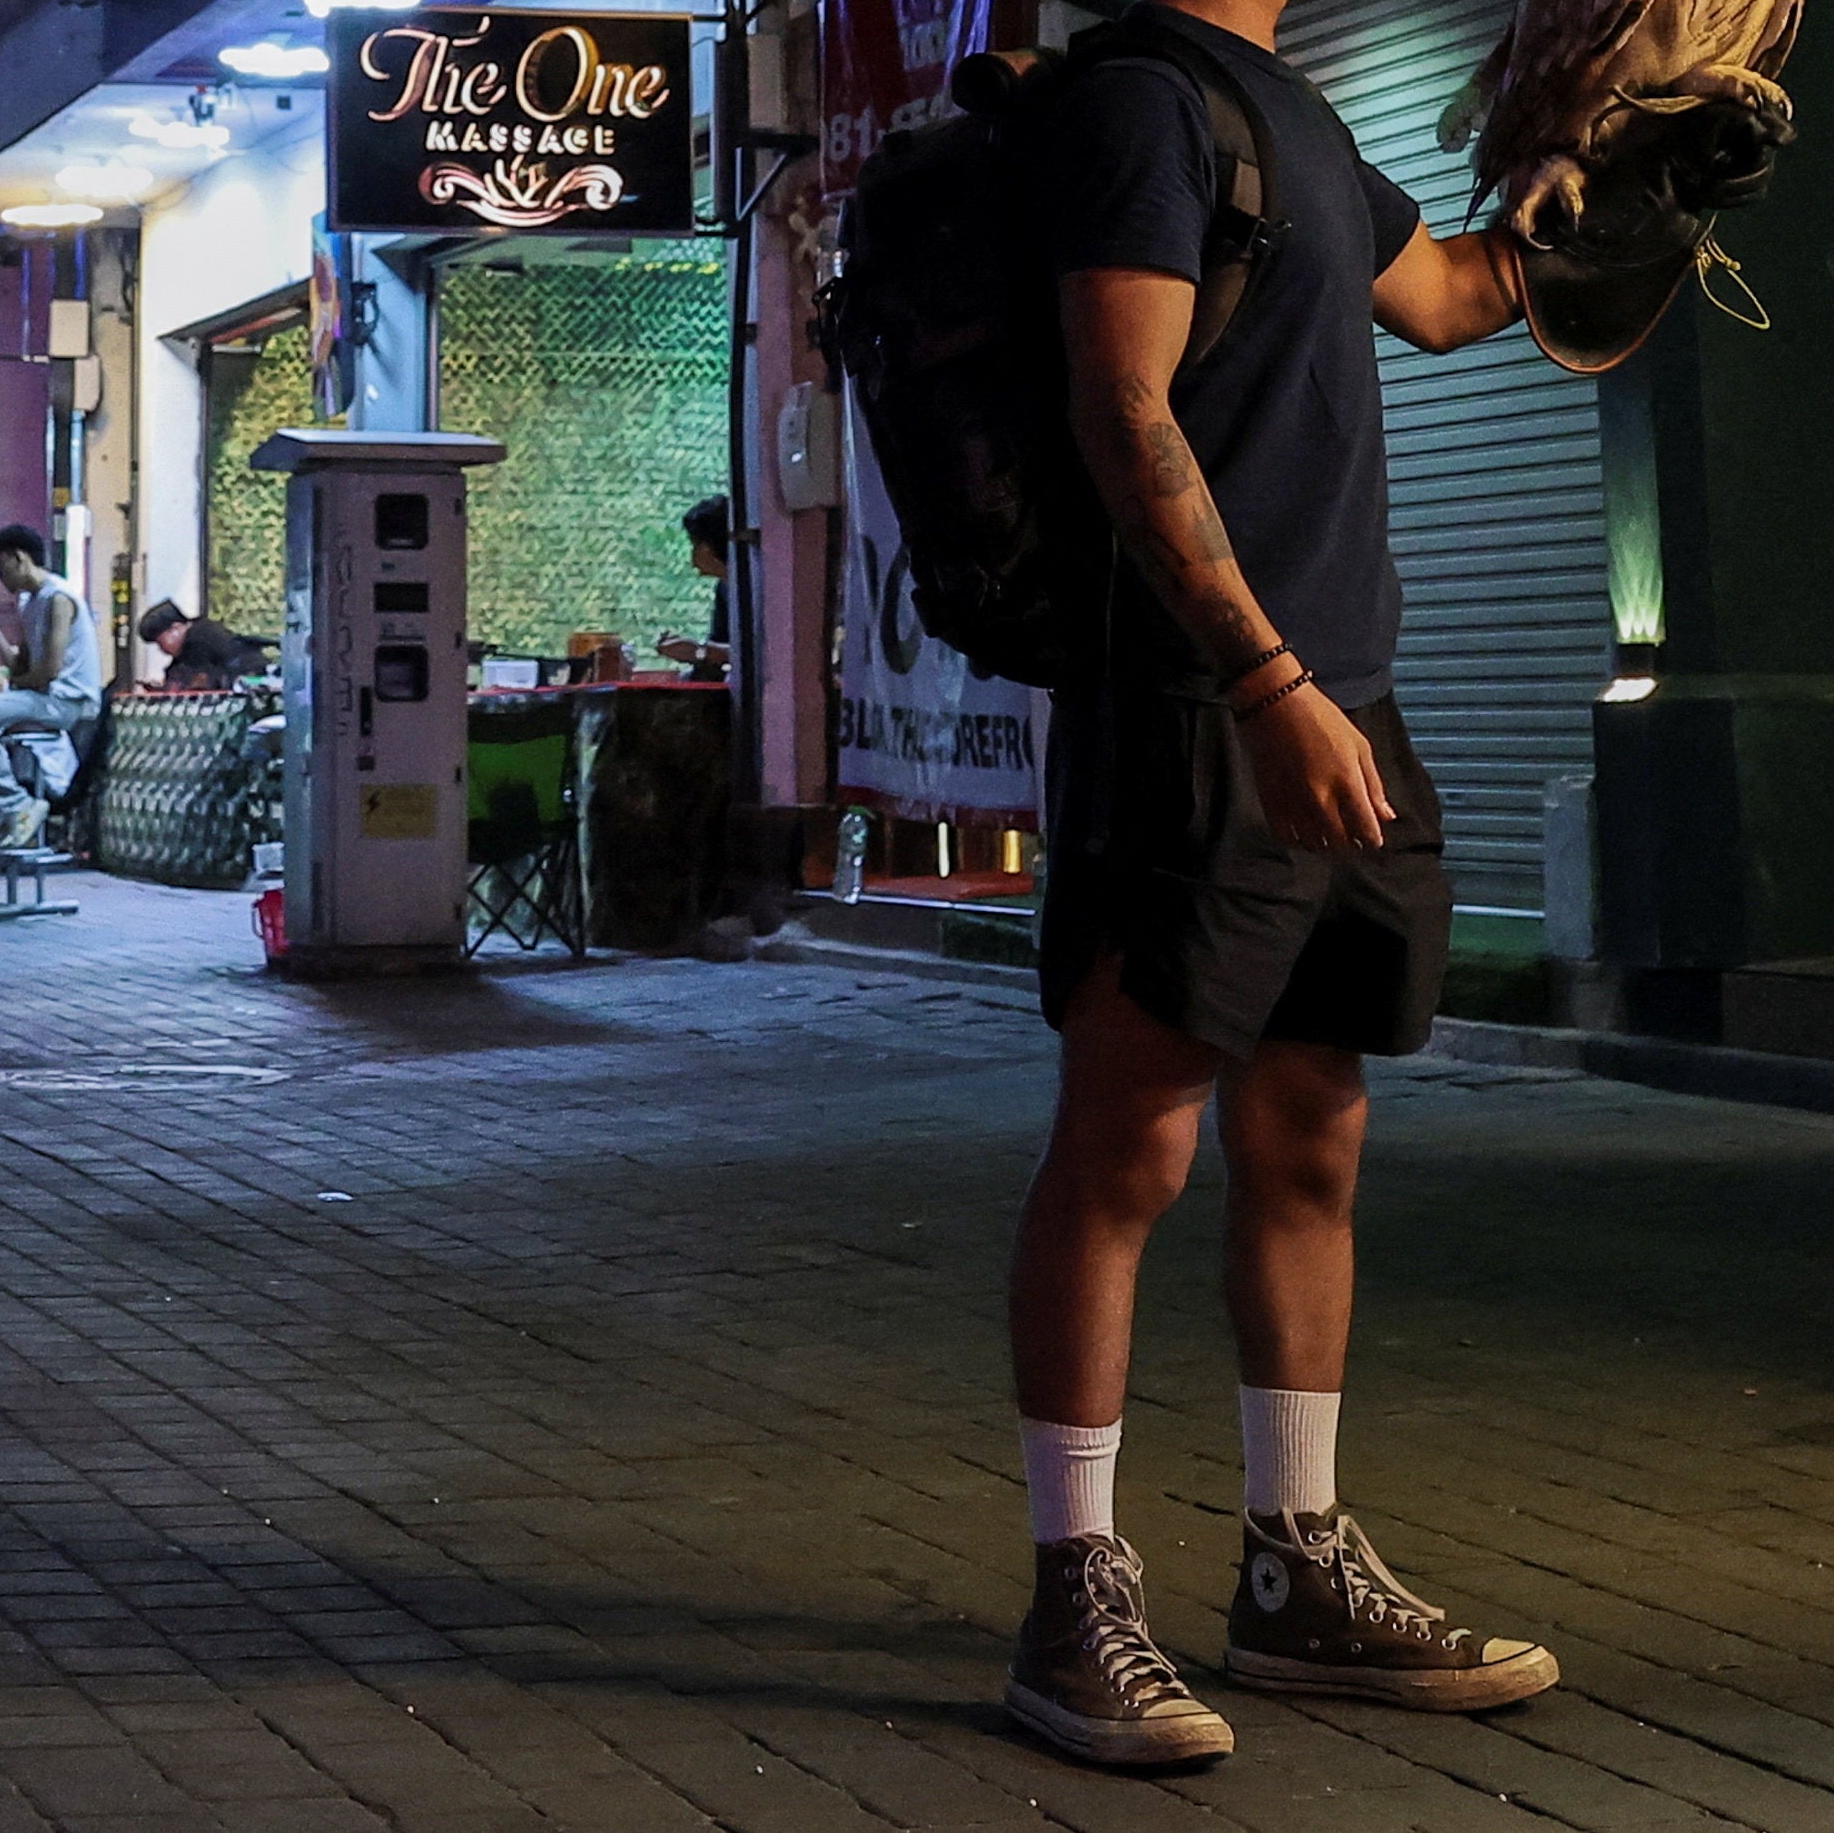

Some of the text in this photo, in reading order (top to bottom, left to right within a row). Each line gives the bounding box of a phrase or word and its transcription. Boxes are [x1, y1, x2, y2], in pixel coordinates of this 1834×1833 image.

[360, 15, 671, 123] The One
[424, 120, 617, 156] MASSAGE
